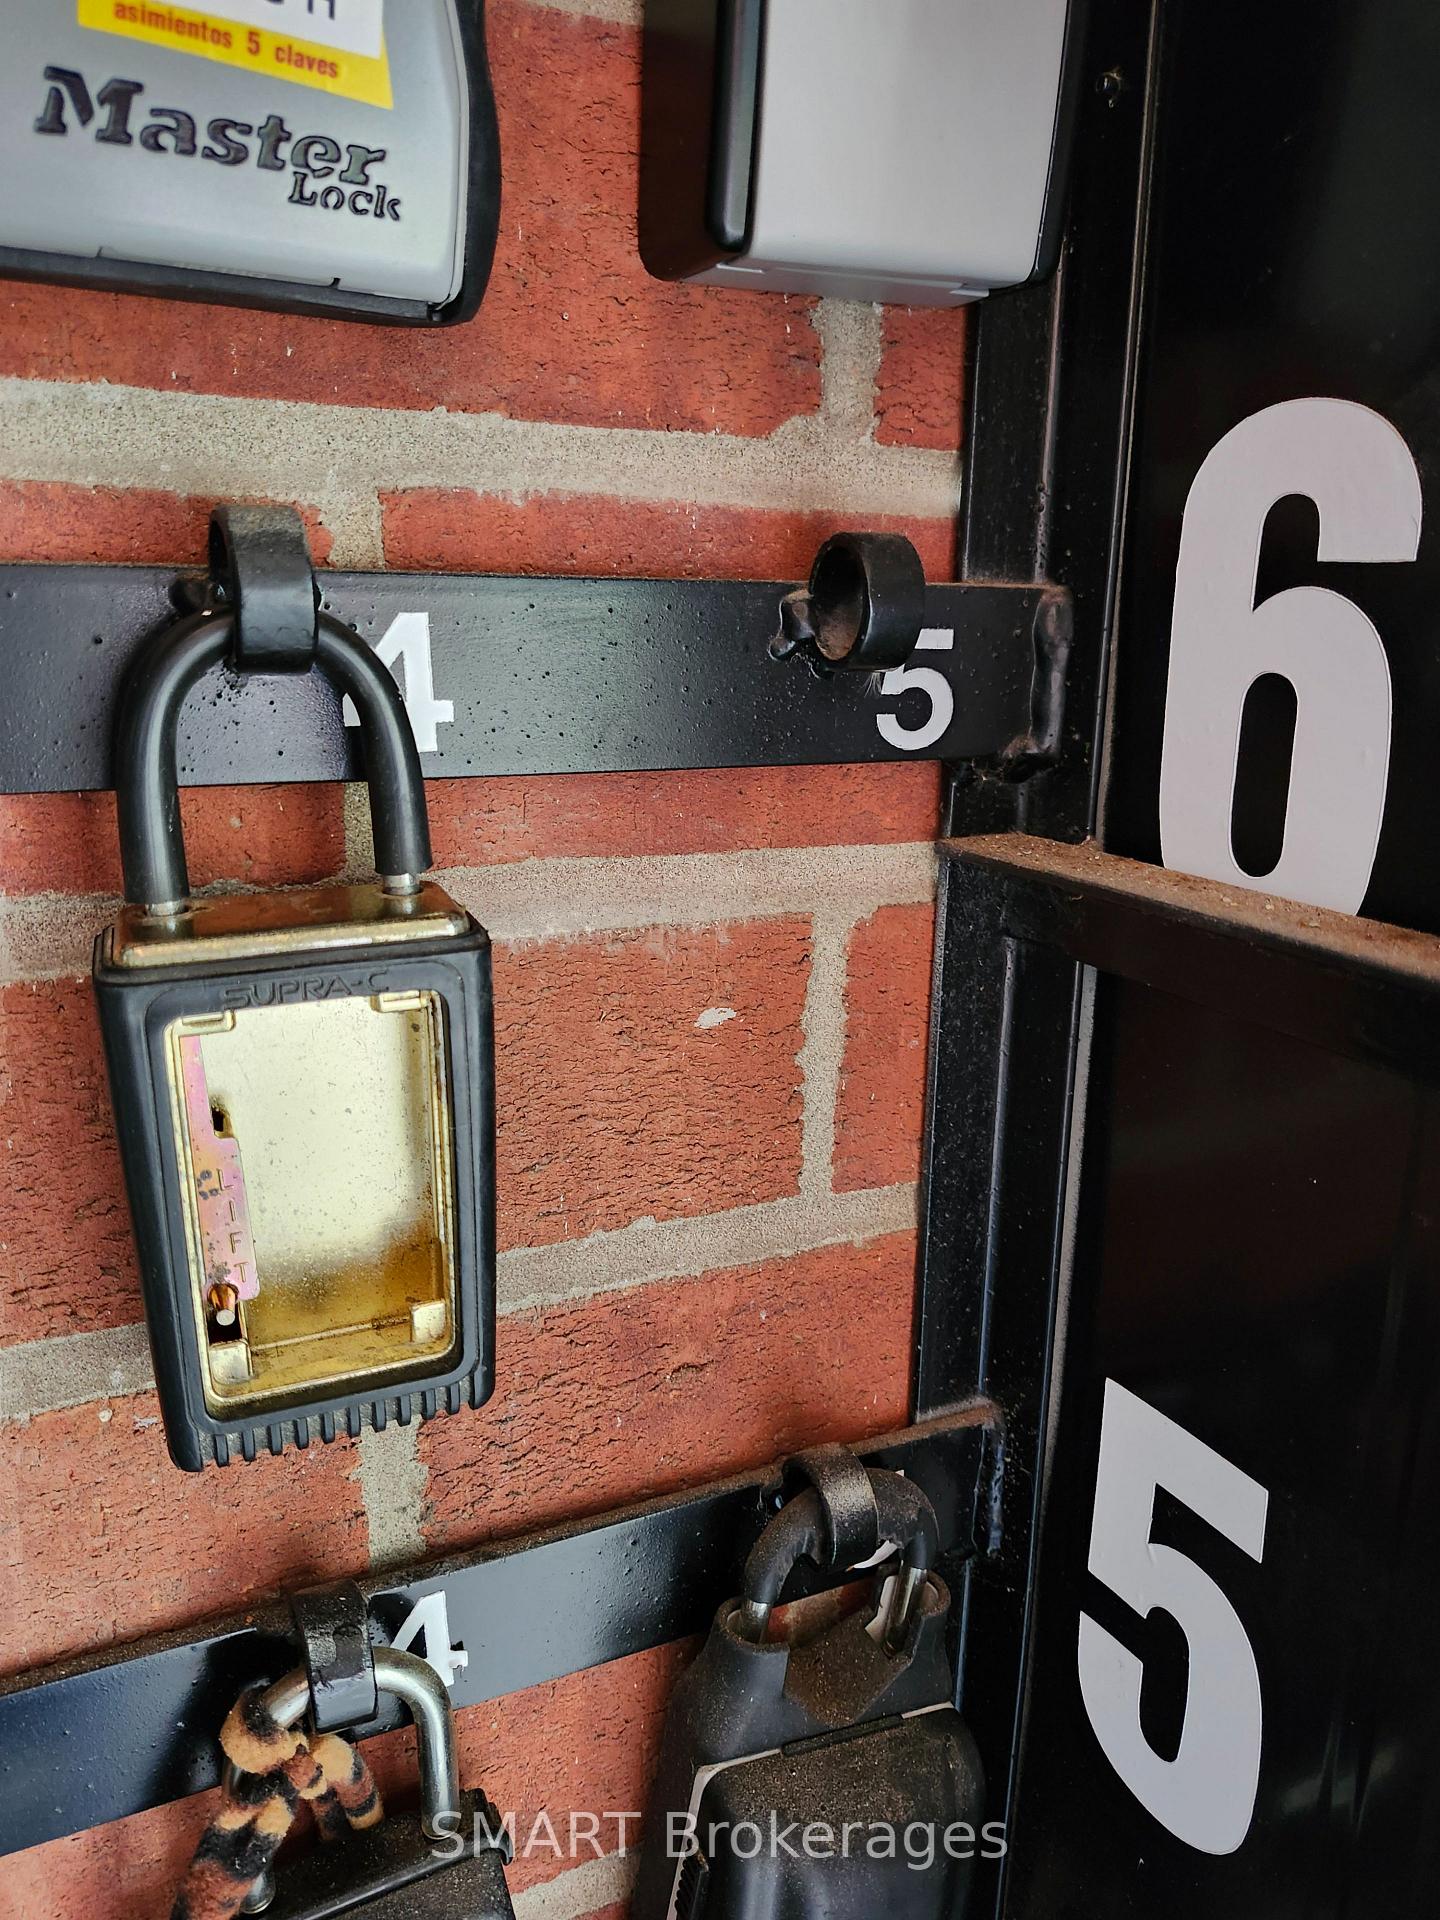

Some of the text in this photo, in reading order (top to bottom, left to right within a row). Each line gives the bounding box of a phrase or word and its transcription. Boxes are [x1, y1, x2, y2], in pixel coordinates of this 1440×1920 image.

[114, 2, 232, 48] asimientos
[246, 31, 261, 56] 5
[274, 44, 338, 79] claves
[34, 65, 386, 185] Master
[288, 171, 401, 221] Lock
[343, 612, 454, 752] 4
[875, 628, 954, 751] 5
[1159, 397, 1423, 917] 6
[221, 968, 390, 1010] SUPRA-C
[390, 1590, 468, 1687] 4
[1078, 1377, 1268, 1856] 5
